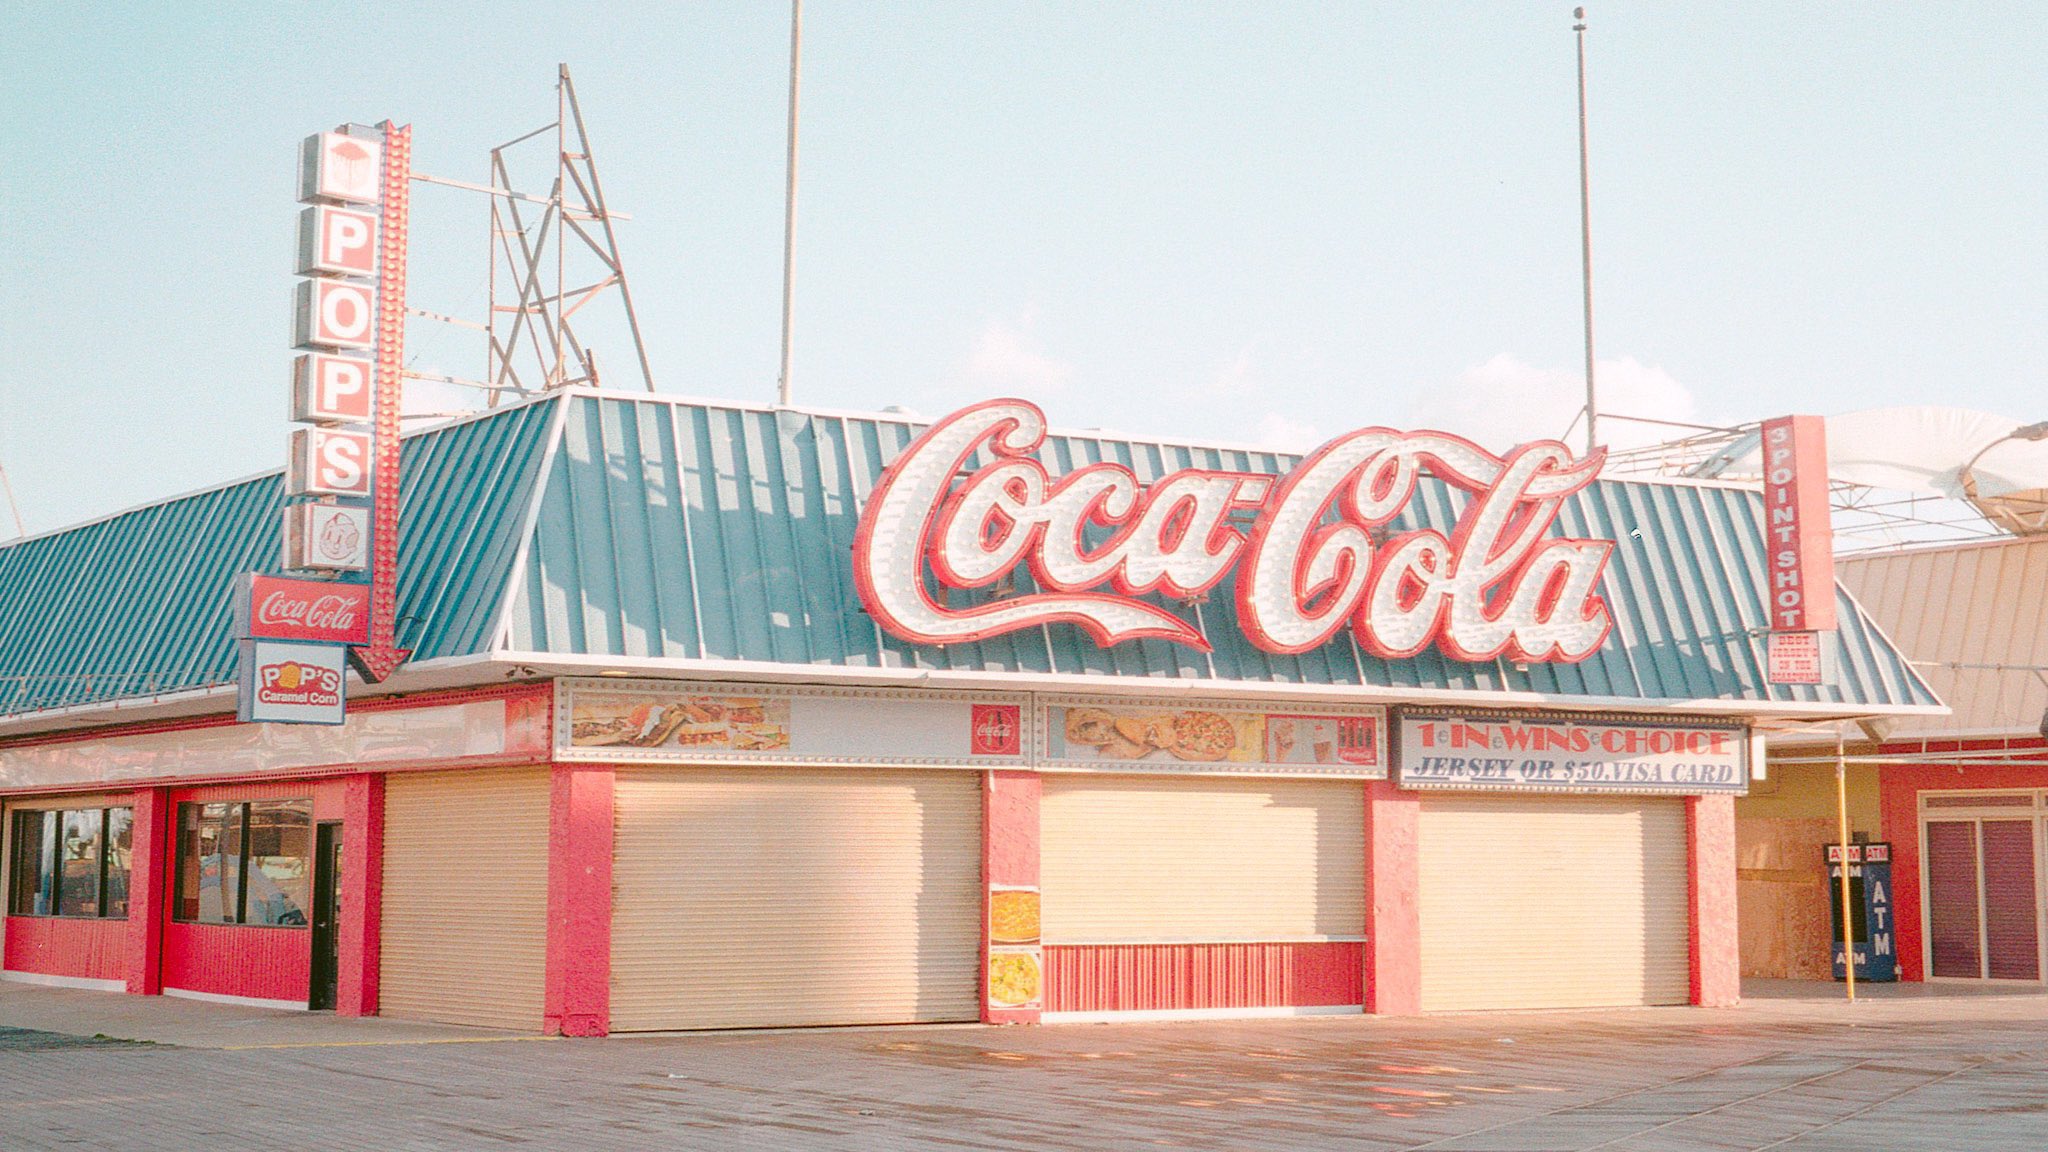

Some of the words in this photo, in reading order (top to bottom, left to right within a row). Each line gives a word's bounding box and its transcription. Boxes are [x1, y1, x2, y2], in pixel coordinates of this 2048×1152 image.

[1771, 447, 1795, 542] POINT
[1777, 551, 1801, 627] SHOT
[261, 690, 308, 702] Caramel
[310, 692, 336, 704] Corn
[1416, 723, 1434, 748] 1
[1450, 724, 1490, 750] IN
[1501, 726, 1591, 752] WINS
[1601, 729, 1731, 755] CHOICE
[1414, 757, 1514, 778] JERSEY
[1520, 759, 1555, 779] OR
[1670, 764, 1733, 783] CARD
[1830, 847, 1861, 860] AM
[1866, 847, 1888, 859] ATM
[1832, 865, 1862, 878] AM
[1873, 881, 1890, 956] ATM
[1835, 952, 1866, 965] AM
